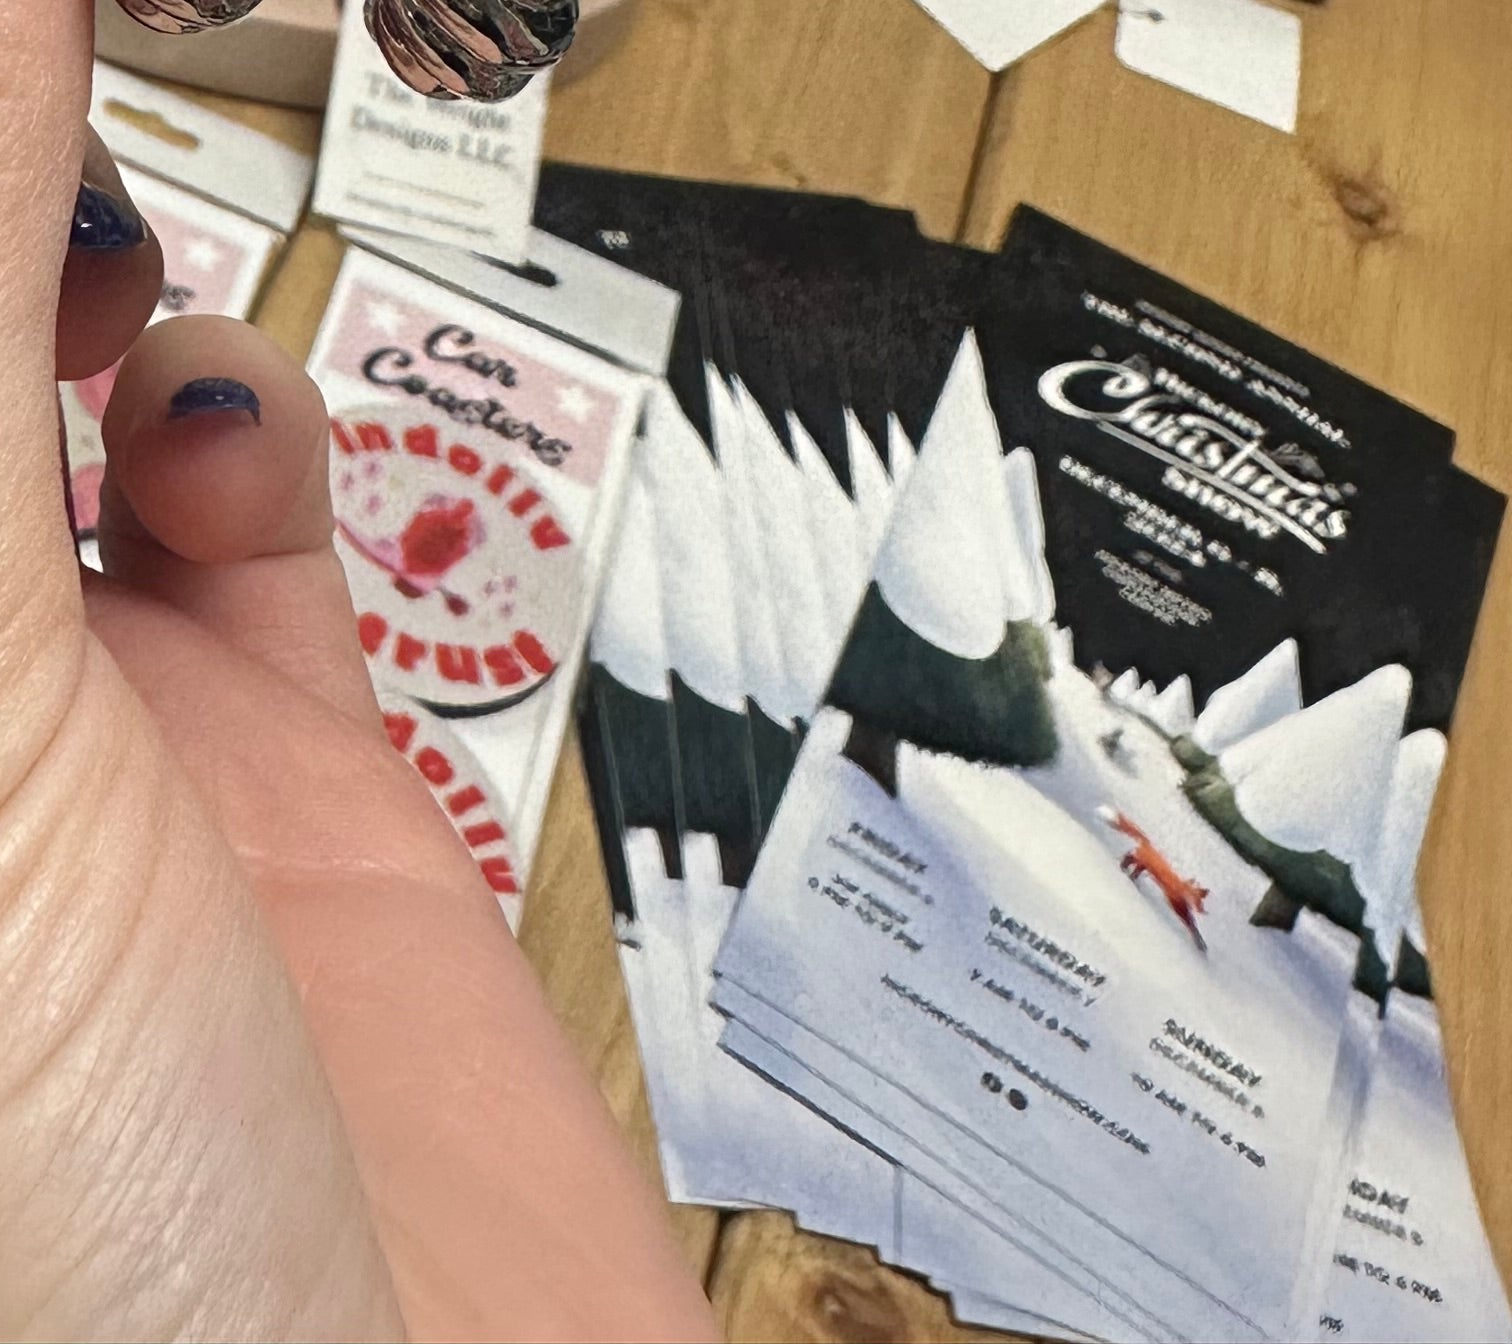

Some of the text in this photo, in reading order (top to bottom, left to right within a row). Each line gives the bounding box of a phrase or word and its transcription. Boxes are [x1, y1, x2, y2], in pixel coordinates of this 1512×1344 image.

[424, 323, 518, 389] Car
[362, 346, 574, 467] Coasters
[1037, 358, 1349, 540] Christmas
[1163, 1018, 1263, 1088] SUNDAY
